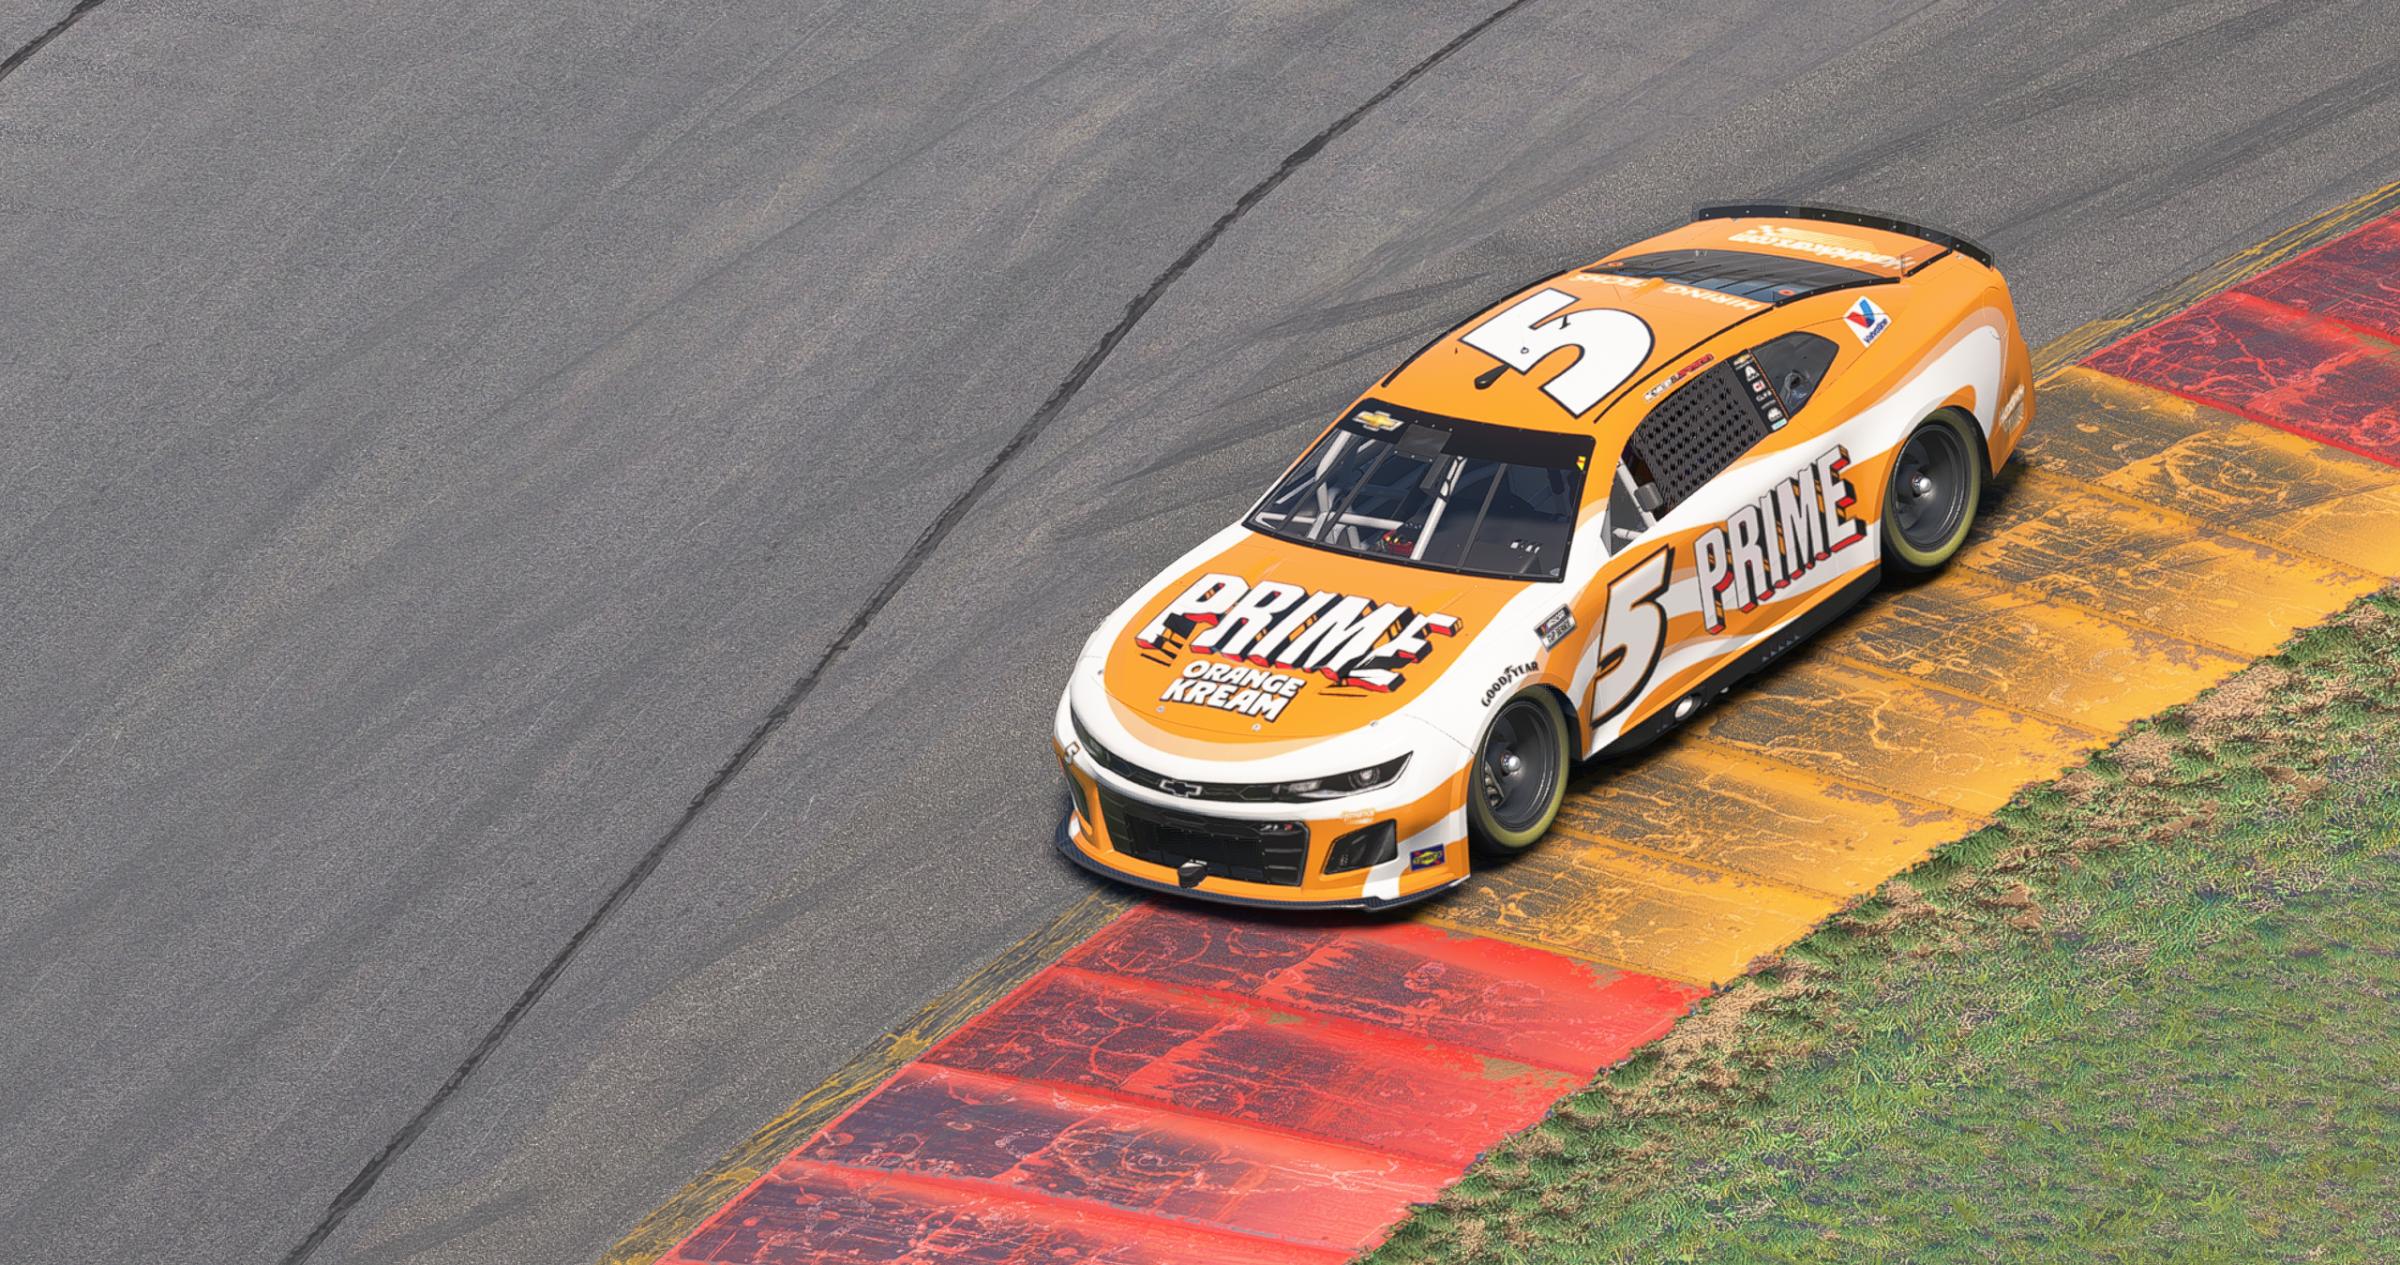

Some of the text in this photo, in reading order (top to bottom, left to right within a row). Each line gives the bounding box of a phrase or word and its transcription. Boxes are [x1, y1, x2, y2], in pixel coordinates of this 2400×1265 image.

[1662, 285, 1762, 311] HIRING
[1456, 287, 1655, 420] 5
[1694, 444, 1868, 635] PRIME
[1134, 573, 1463, 692] PRIME
[1590, 544, 1675, 730] 5
[1159, 677, 1291, 723] KREAM
[1182, 660, 1306, 697] ORANGE
[1481, 660, 1539, 707] GOODYEAR
